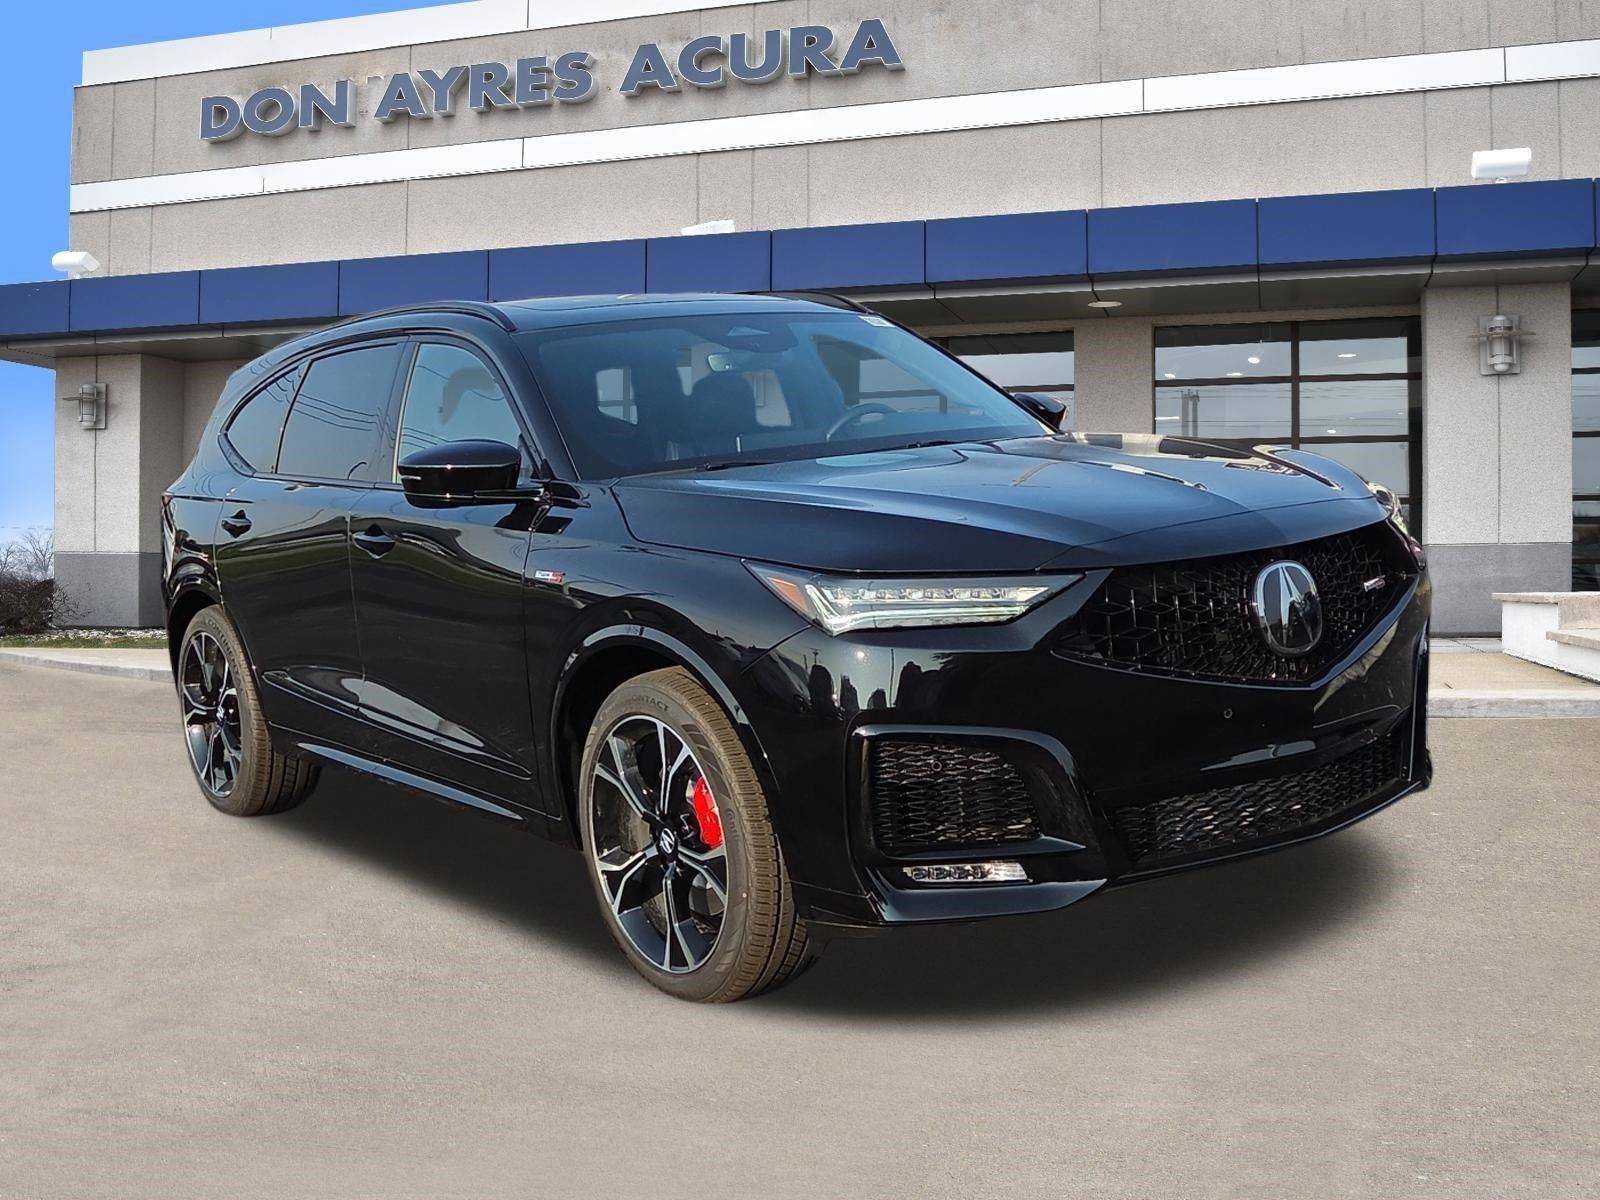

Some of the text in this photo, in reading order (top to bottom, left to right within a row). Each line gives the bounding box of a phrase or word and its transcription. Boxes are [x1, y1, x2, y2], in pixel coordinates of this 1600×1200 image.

[199, 18, 905, 142] DON AYRES ACURA
